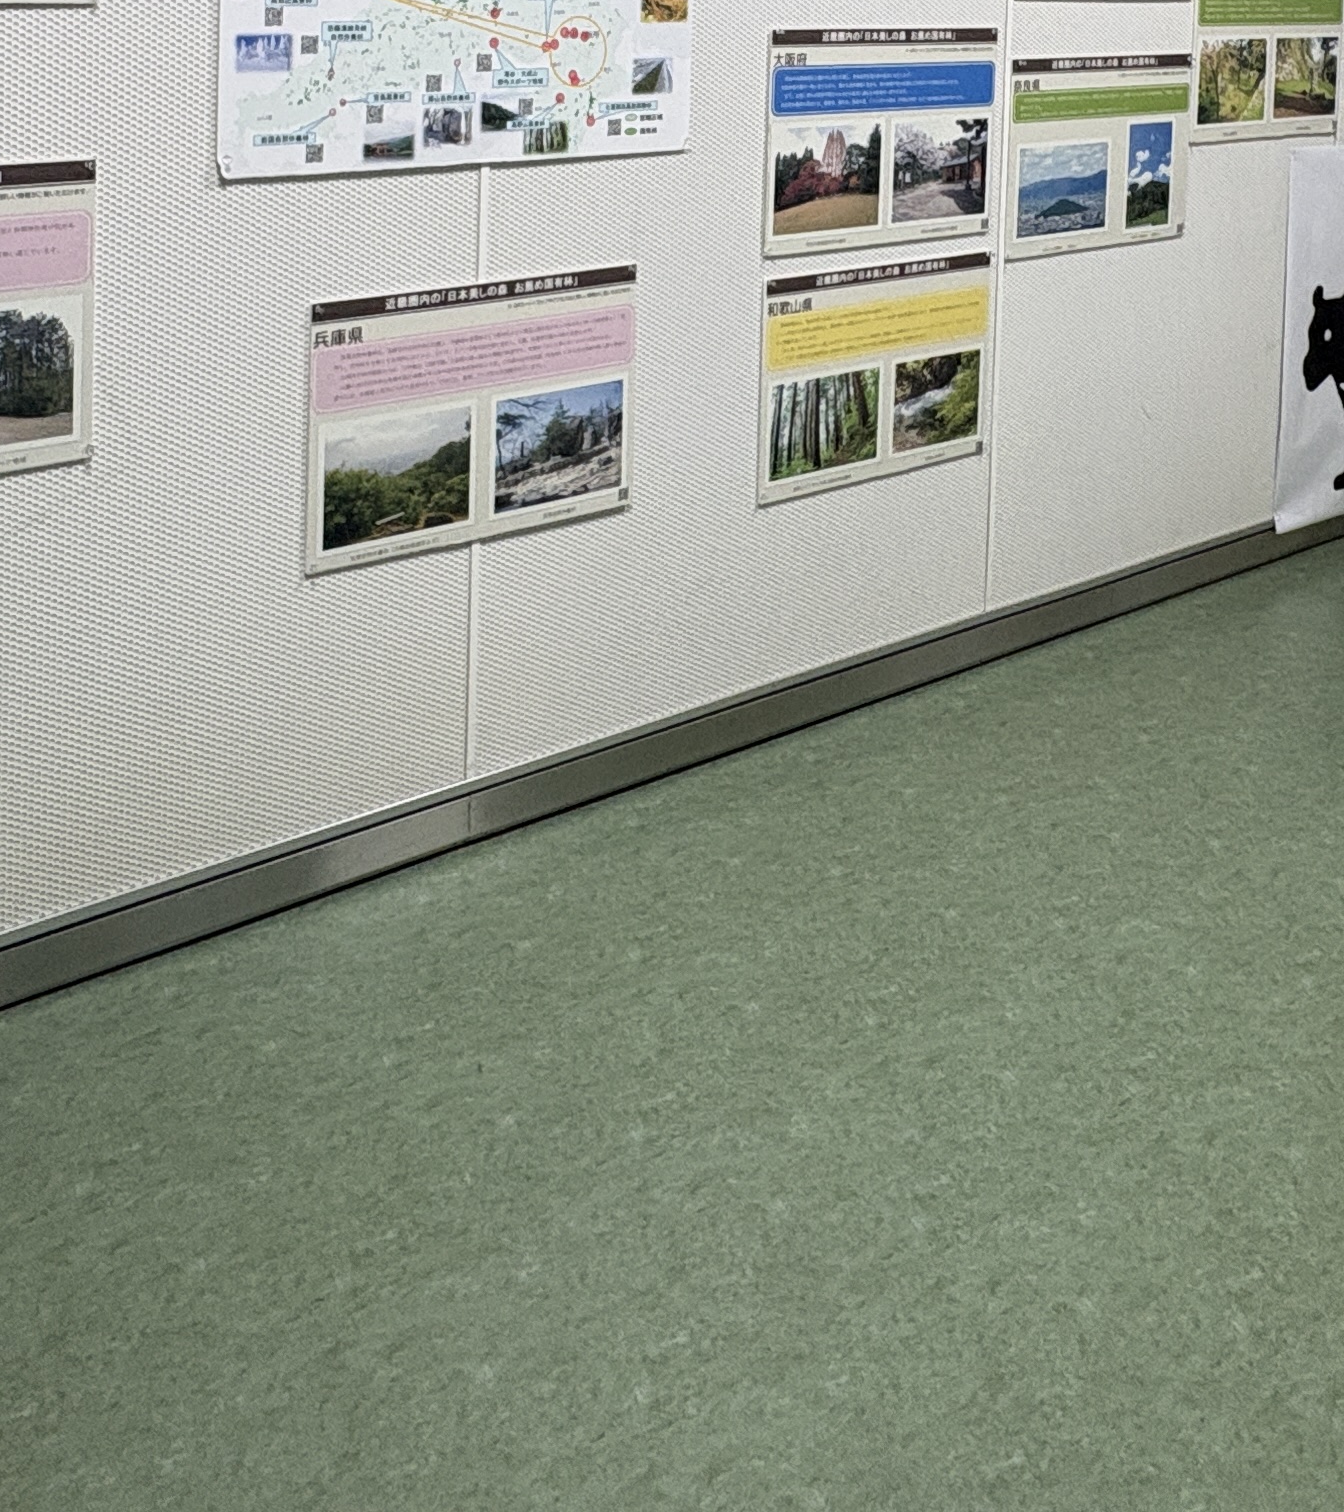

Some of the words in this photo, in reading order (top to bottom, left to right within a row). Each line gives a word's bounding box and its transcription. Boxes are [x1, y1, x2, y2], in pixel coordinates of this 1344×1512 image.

[774, 53, 807, 66] 大阪府
[768, 298, 812, 317] 和歌山県
[313, 326, 363, 349] 兵庫県
